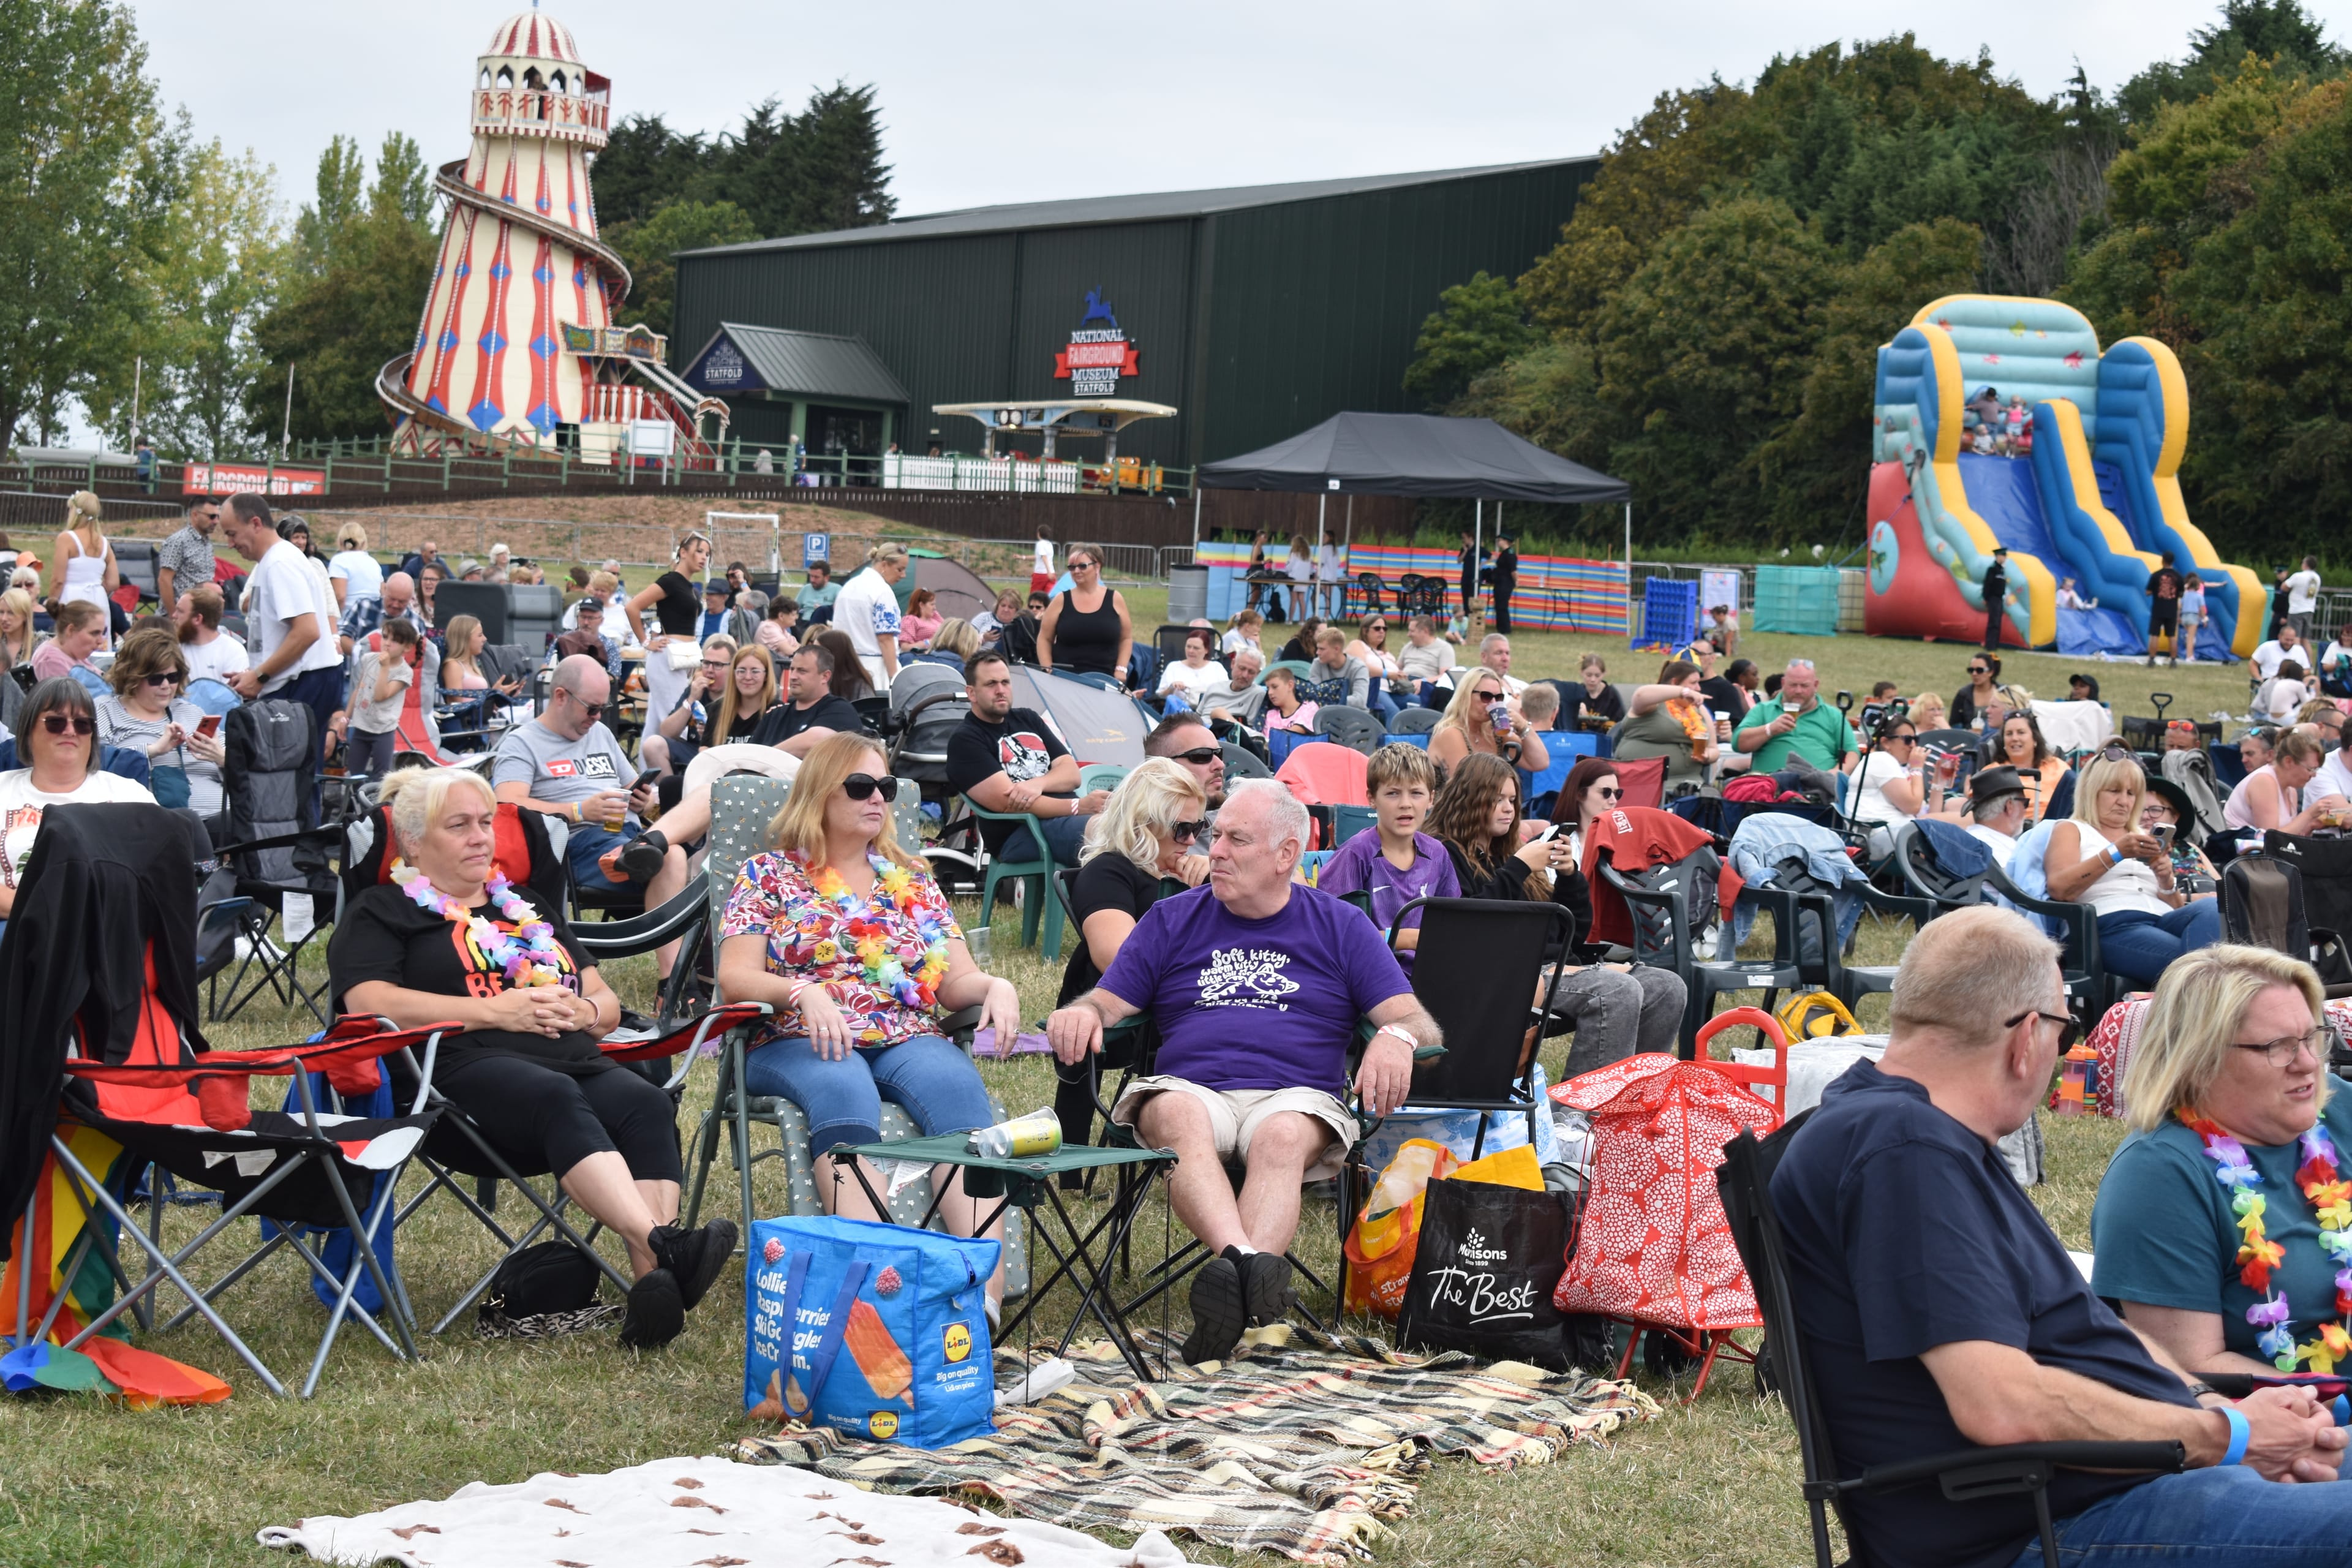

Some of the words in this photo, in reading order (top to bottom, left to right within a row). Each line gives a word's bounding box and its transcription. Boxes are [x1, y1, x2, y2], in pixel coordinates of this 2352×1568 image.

[1071, 330, 1125, 344] NATIONAL
[1068, 345, 1125, 366] FAIRGROUND
[706, 368, 742, 379] STATFOLD
[1072, 367, 1120, 381] MUSEUM
[1074, 383, 1115, 393] STATFOLD
[812, 538, 821, 549] P
[1212, 948, 1245, 968] Soft
[1250, 949, 1291, 968] kitty,
[1201, 964, 1233, 976] warm
[1234, 960, 1259, 971] kitty
[1197, 975, 1224, 987] little
[1427, 1264, 1468, 1310] The
[1466, 1272, 1539, 1315] Best
[757, 1291, 831, 1327] Rasperries
[755, 1313, 767, 1336] Ski
[767, 1319, 823, 1351] Gogles
[767, 1342, 811, 1371] Crm.
[937, 1371, 947, 1382] Big
[957, 1365, 979, 1378] quality
[962, 1381, 975, 1390] price
[843, 1417, 862, 1426] quality
